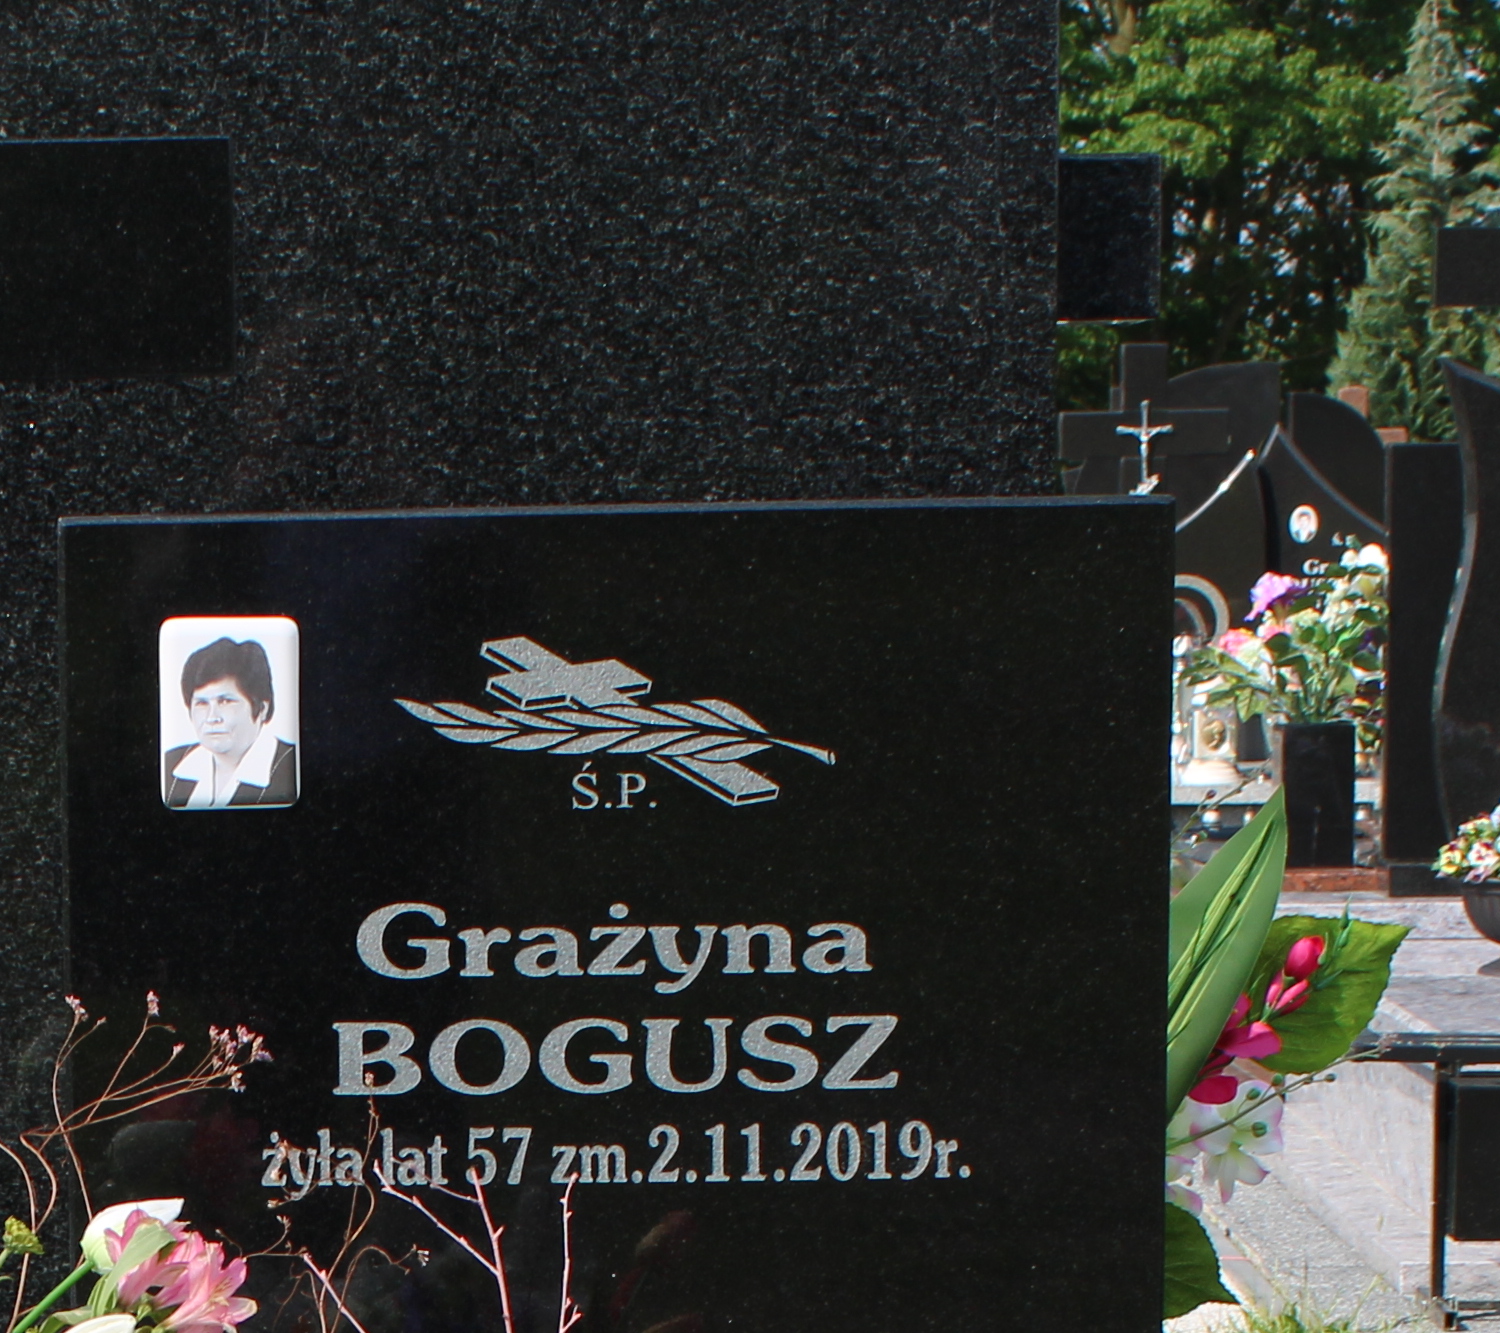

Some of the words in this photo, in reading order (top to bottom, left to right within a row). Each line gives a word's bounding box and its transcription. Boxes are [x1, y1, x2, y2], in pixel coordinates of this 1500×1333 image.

[572, 762, 658, 809] Ś.P.
[356, 902, 873, 994] Grażyna
[332, 1015, 899, 1096] BOGUSZ
[261, 1127, 364, 1190] żyła
[381, 1126, 448, 1186] lat
[466, 1125, 533, 1185] 57
